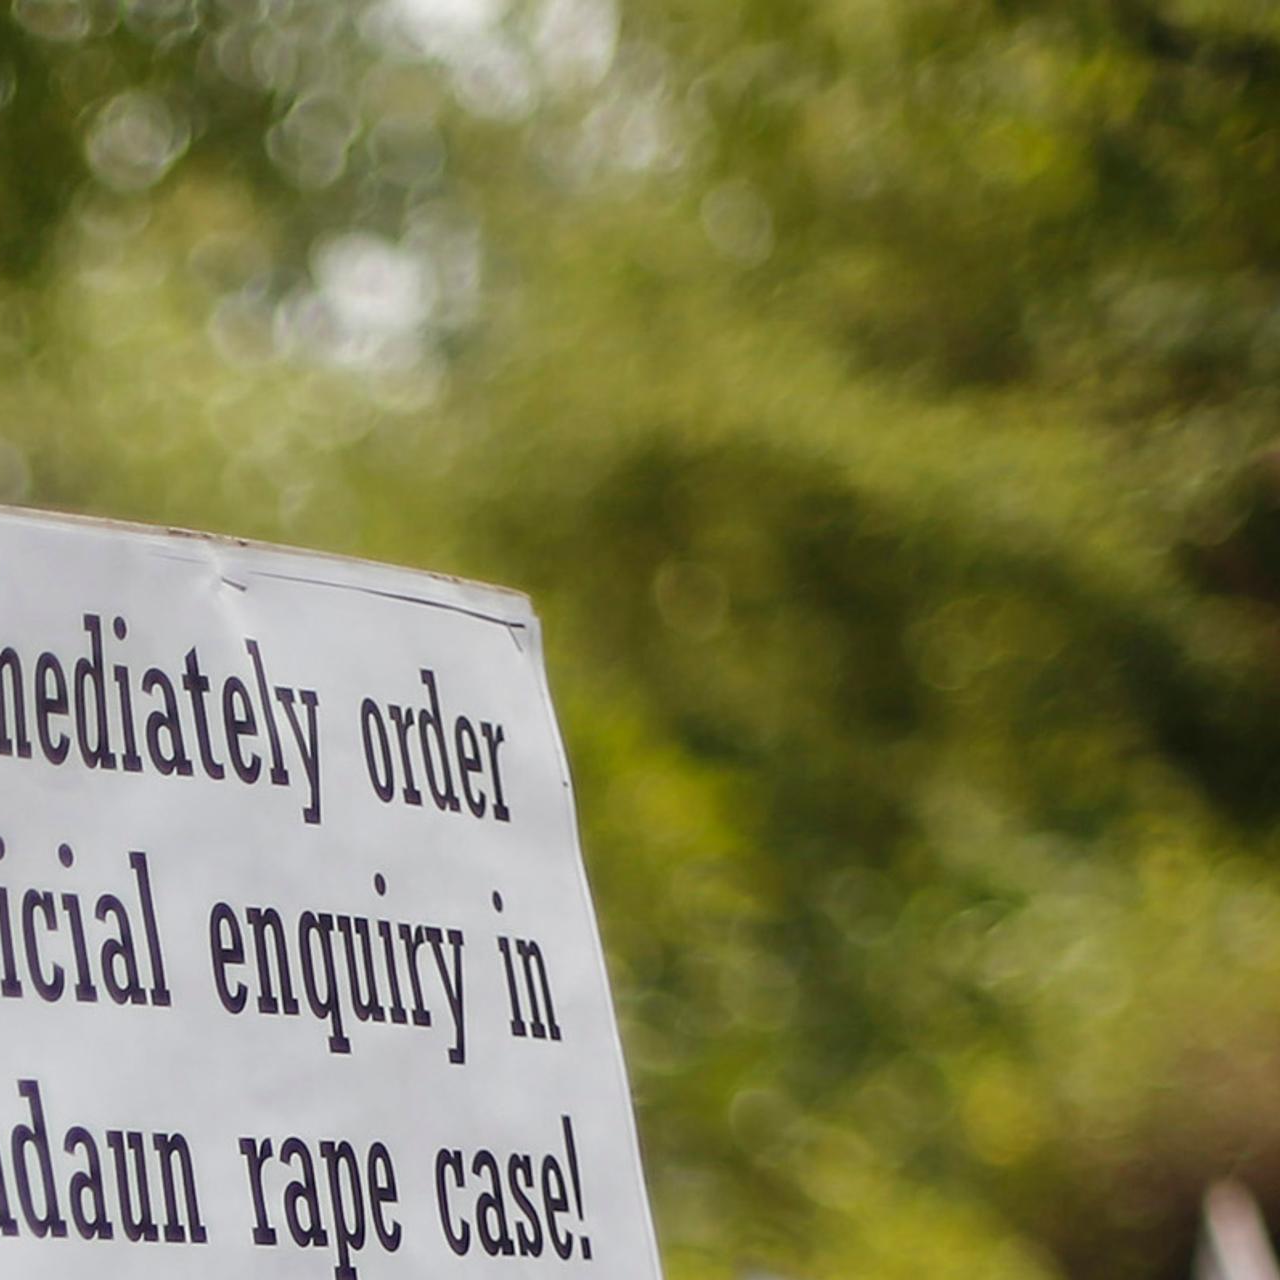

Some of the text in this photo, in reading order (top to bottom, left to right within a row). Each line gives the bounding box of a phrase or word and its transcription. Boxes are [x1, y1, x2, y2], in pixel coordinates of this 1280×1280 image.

[361, 671, 510, 823] order
[209, 875, 466, 1064] enquiry
[492, 892, 561, 1041] in
[436, 1116, 592, 1261] case!
